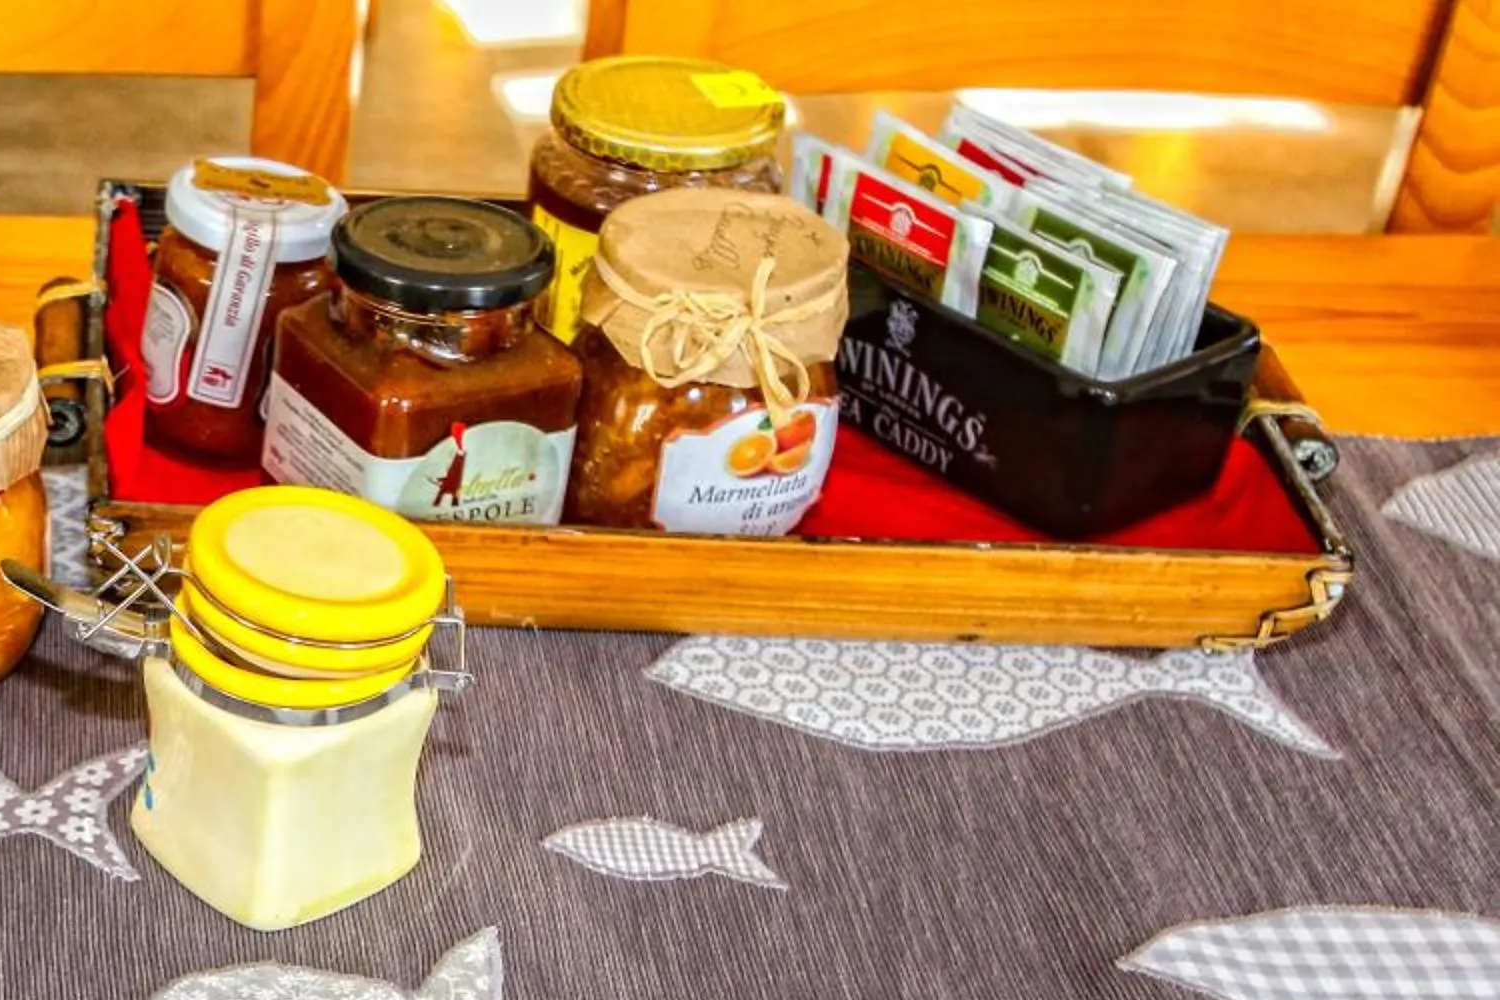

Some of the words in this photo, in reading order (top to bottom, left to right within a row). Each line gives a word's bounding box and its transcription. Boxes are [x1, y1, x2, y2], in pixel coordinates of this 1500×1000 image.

[839, 337, 985, 451] WININGS
[873, 412, 954, 474] CADDY
[687, 475, 808, 504] Marmellata
[741, 501, 762, 520] di
